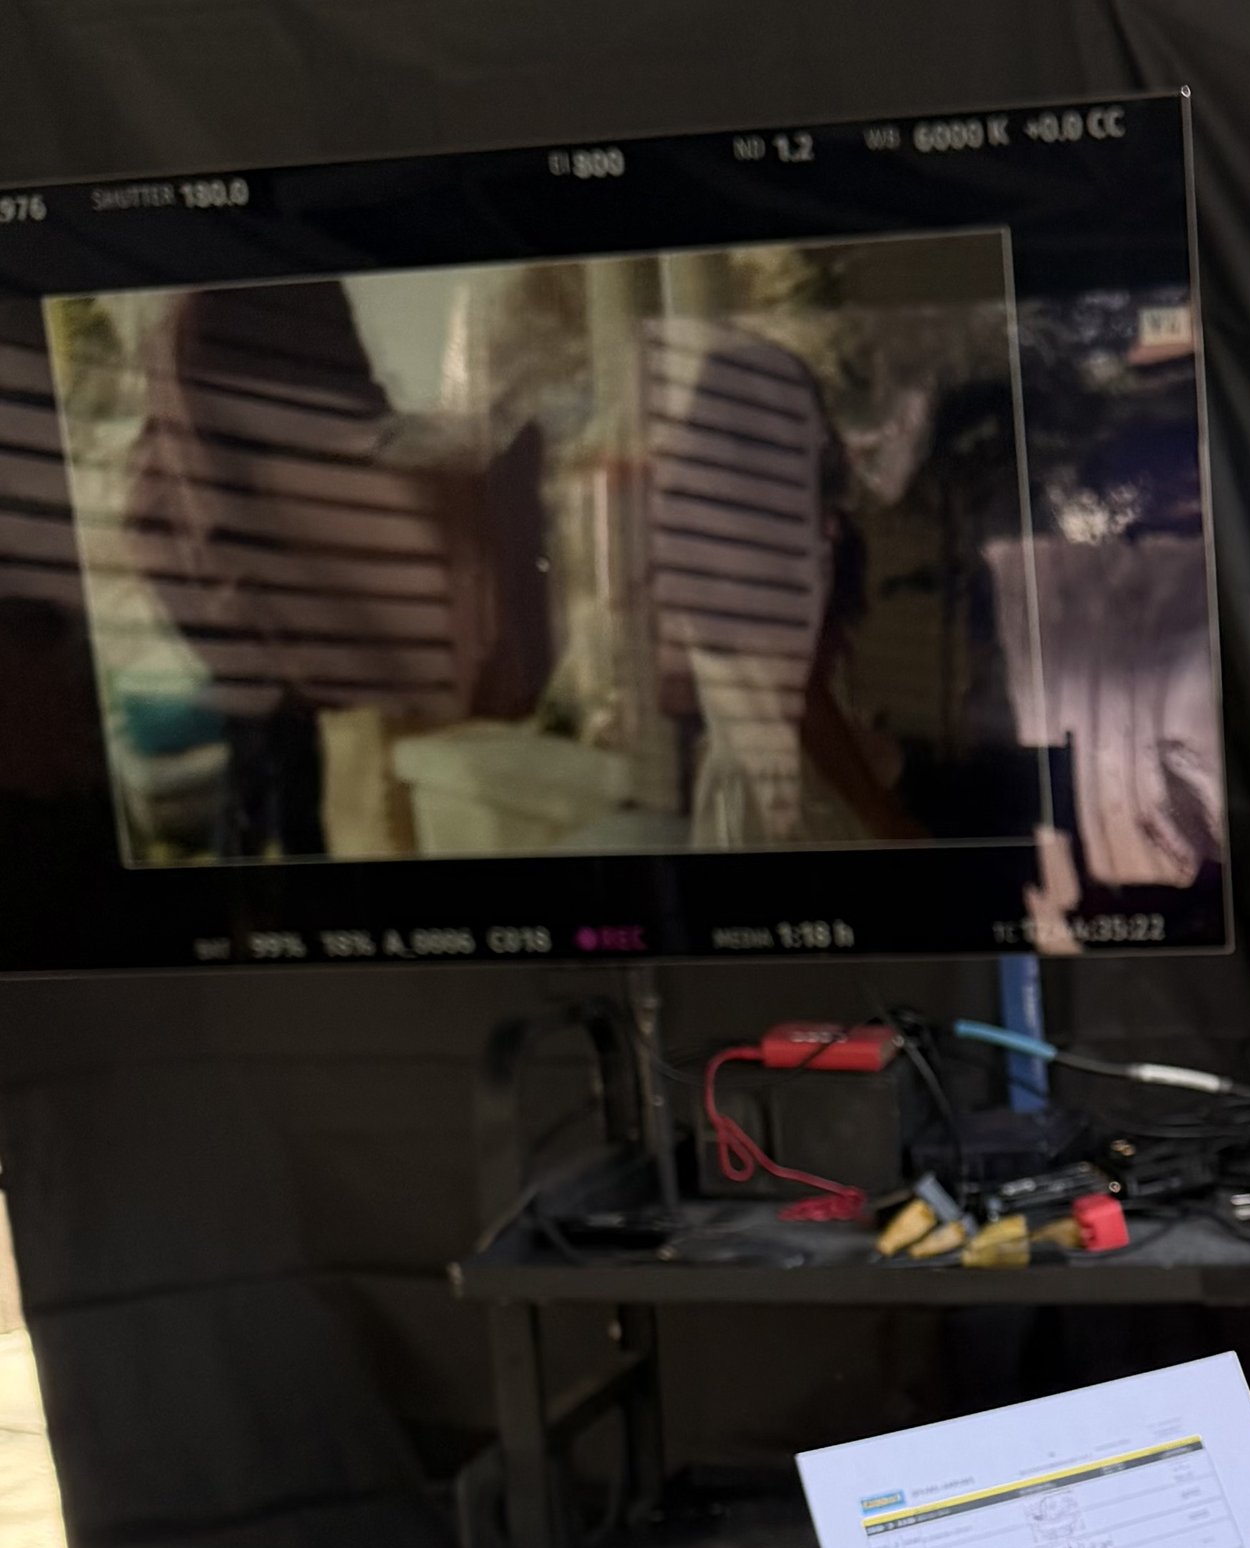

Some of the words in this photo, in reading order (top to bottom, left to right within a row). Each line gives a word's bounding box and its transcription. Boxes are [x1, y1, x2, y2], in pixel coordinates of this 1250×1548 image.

[913, 117, 984, 153] 6000
[986, 113, 1010, 146] K
[1086, 105, 1126, 140] CC
[572, 145, 625, 179] 800
[772, 130, 815, 163] 1.2
[91, 183, 175, 211] SHUTTER
[180, 177, 249, 208] 180.0
